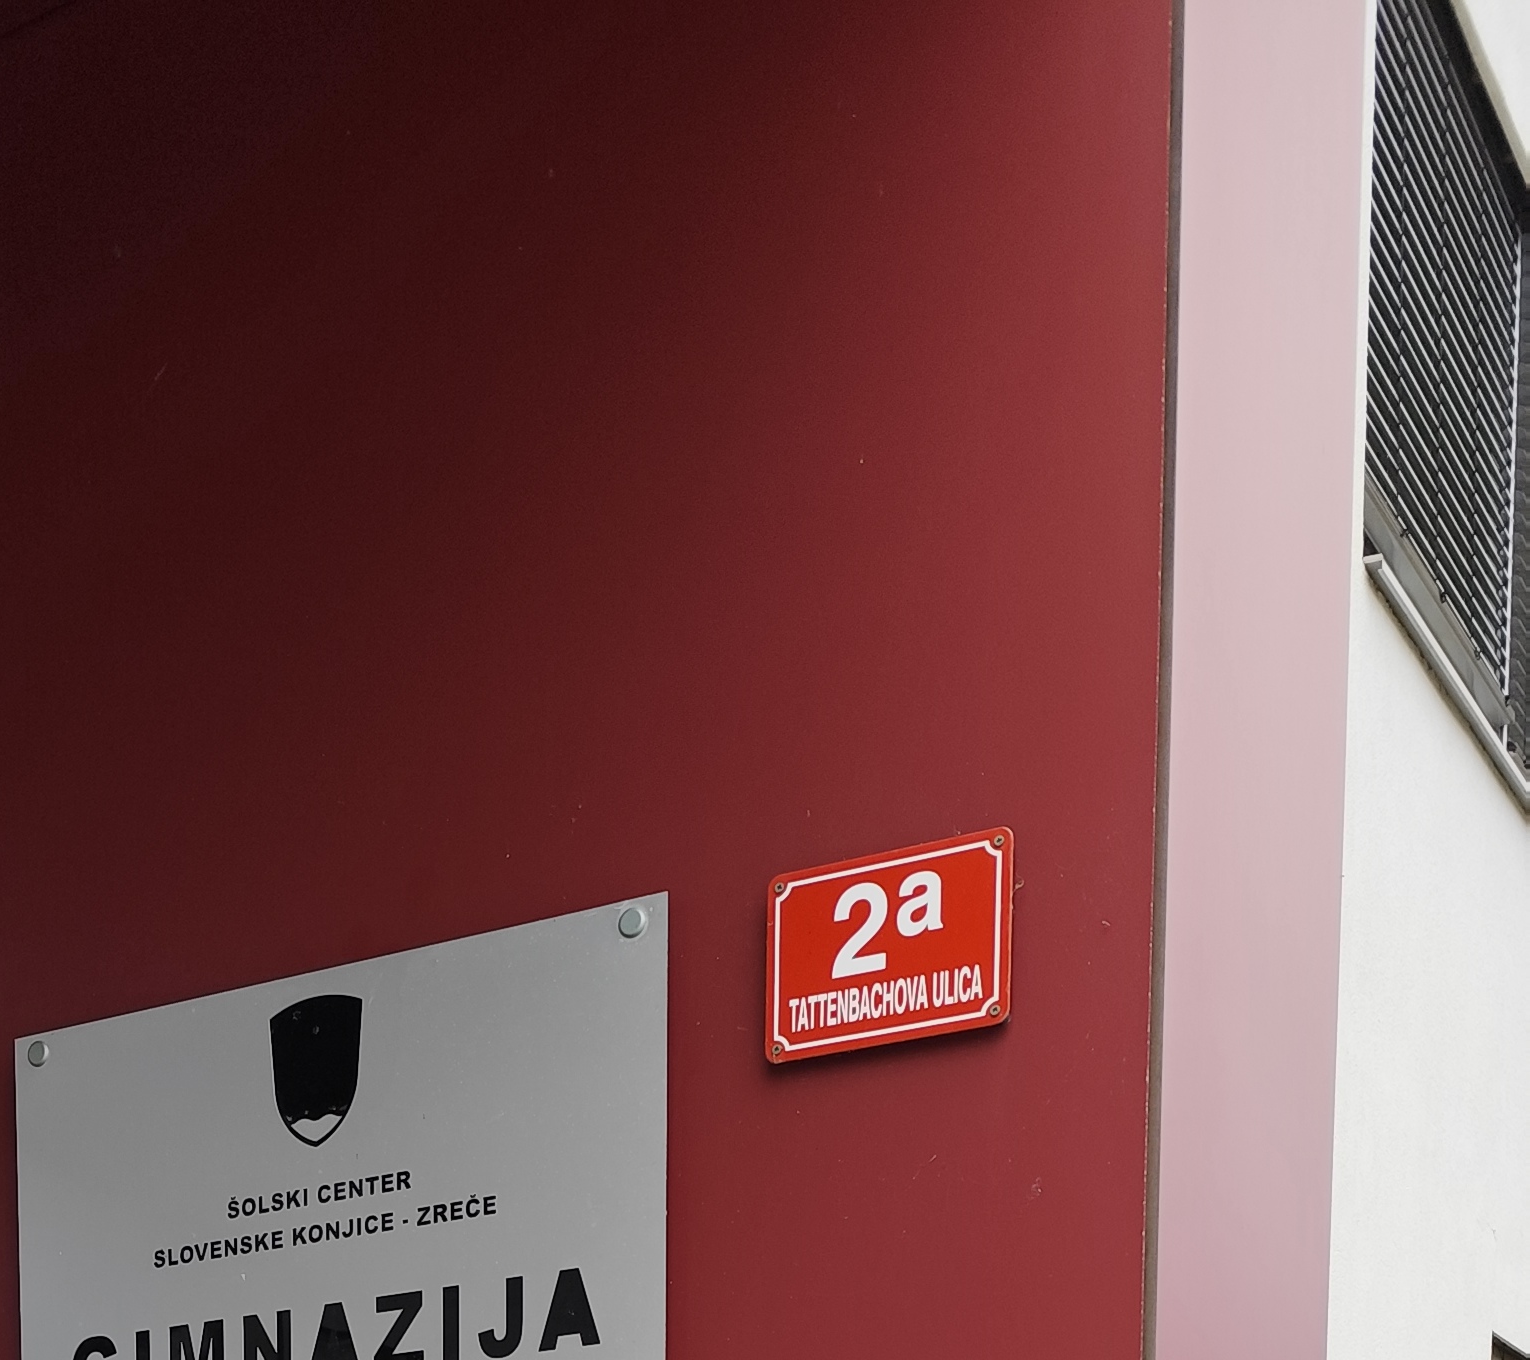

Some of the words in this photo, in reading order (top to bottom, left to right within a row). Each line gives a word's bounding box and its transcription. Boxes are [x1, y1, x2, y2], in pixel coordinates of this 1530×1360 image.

[832, 870, 944, 980] 2a
[789, 974, 929, 1033] TATTENBACHOVA
[932, 964, 983, 1008] ULICA
[227, 1188, 308, 1219] ŠOLSKI
[317, 1170, 412, 1204] CENTER
[153, 1230, 284, 1269] SLOVENSKE
[292, 1212, 394, 1247] KONJICE
[416, 1194, 497, 1227] ZREČE
